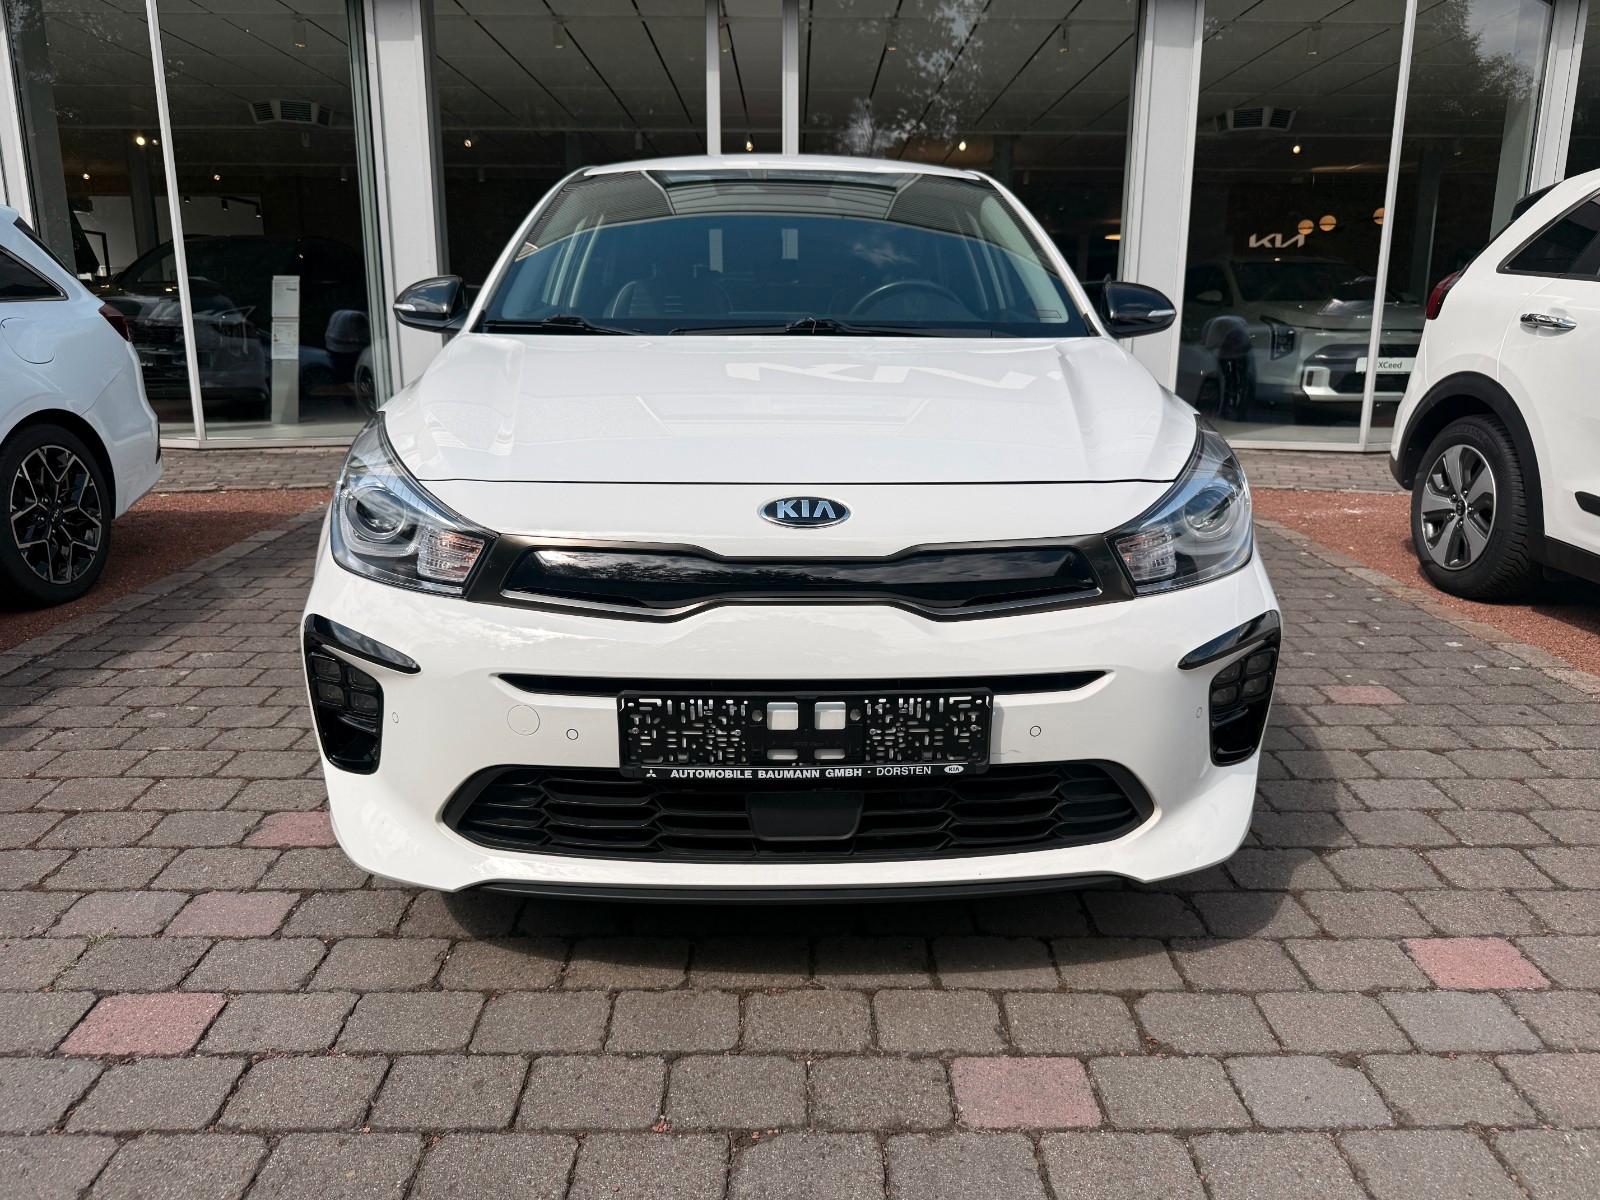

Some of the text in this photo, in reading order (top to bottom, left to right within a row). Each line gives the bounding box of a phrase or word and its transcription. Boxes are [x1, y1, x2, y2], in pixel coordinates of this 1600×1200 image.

[1377, 361, 1403, 370] XCeed
[776, 500, 837, 519] KIA
[670, 769, 753, 779] AUTOMOBILE
[757, 769, 820, 779] BAUMANN
[825, 768, 862, 778] GMBH
[876, 766, 932, 776] DORSTEN
